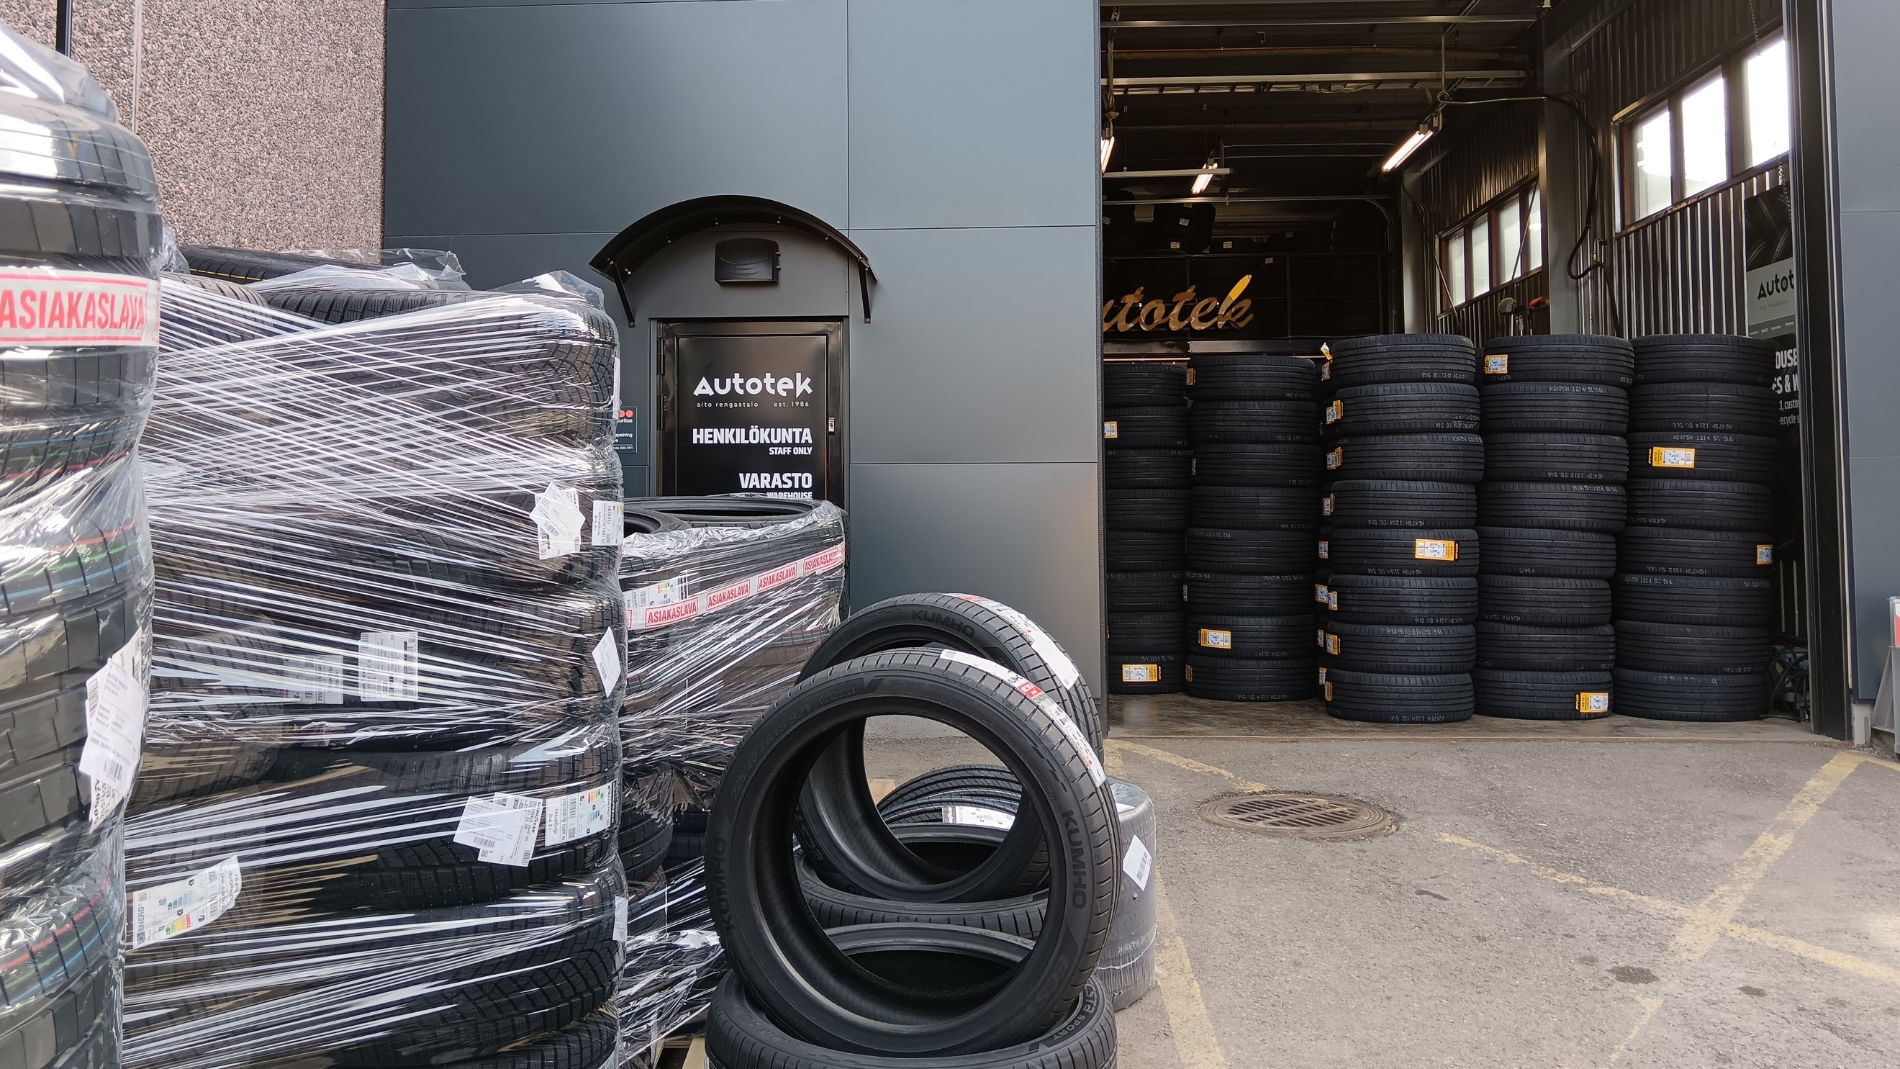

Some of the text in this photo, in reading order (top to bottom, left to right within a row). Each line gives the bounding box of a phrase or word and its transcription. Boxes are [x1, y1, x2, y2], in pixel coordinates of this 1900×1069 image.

[0, 289, 145, 330] ASIAKASLAVA
[693, 372, 813, 399] Autotek
[715, 401, 759, 409] rengastalo
[692, 425, 813, 445] HENKILÖKUNTA
[769, 446, 813, 456] STAFF ONLY
[739, 472, 813, 489] VARASTO
[757, 566, 797, 590] ASIAKASLAVA
[707, 583, 750, 608] ASIAKASLAVA
[647, 600, 698, 624] ASIAKASLAVA
[911, 608, 976, 639] KUMHO
[1060, 808, 1088, 910] KUMHO
[713, 837, 736, 930] KUMHO
[1053, 1014, 1086, 1041] SPORT
